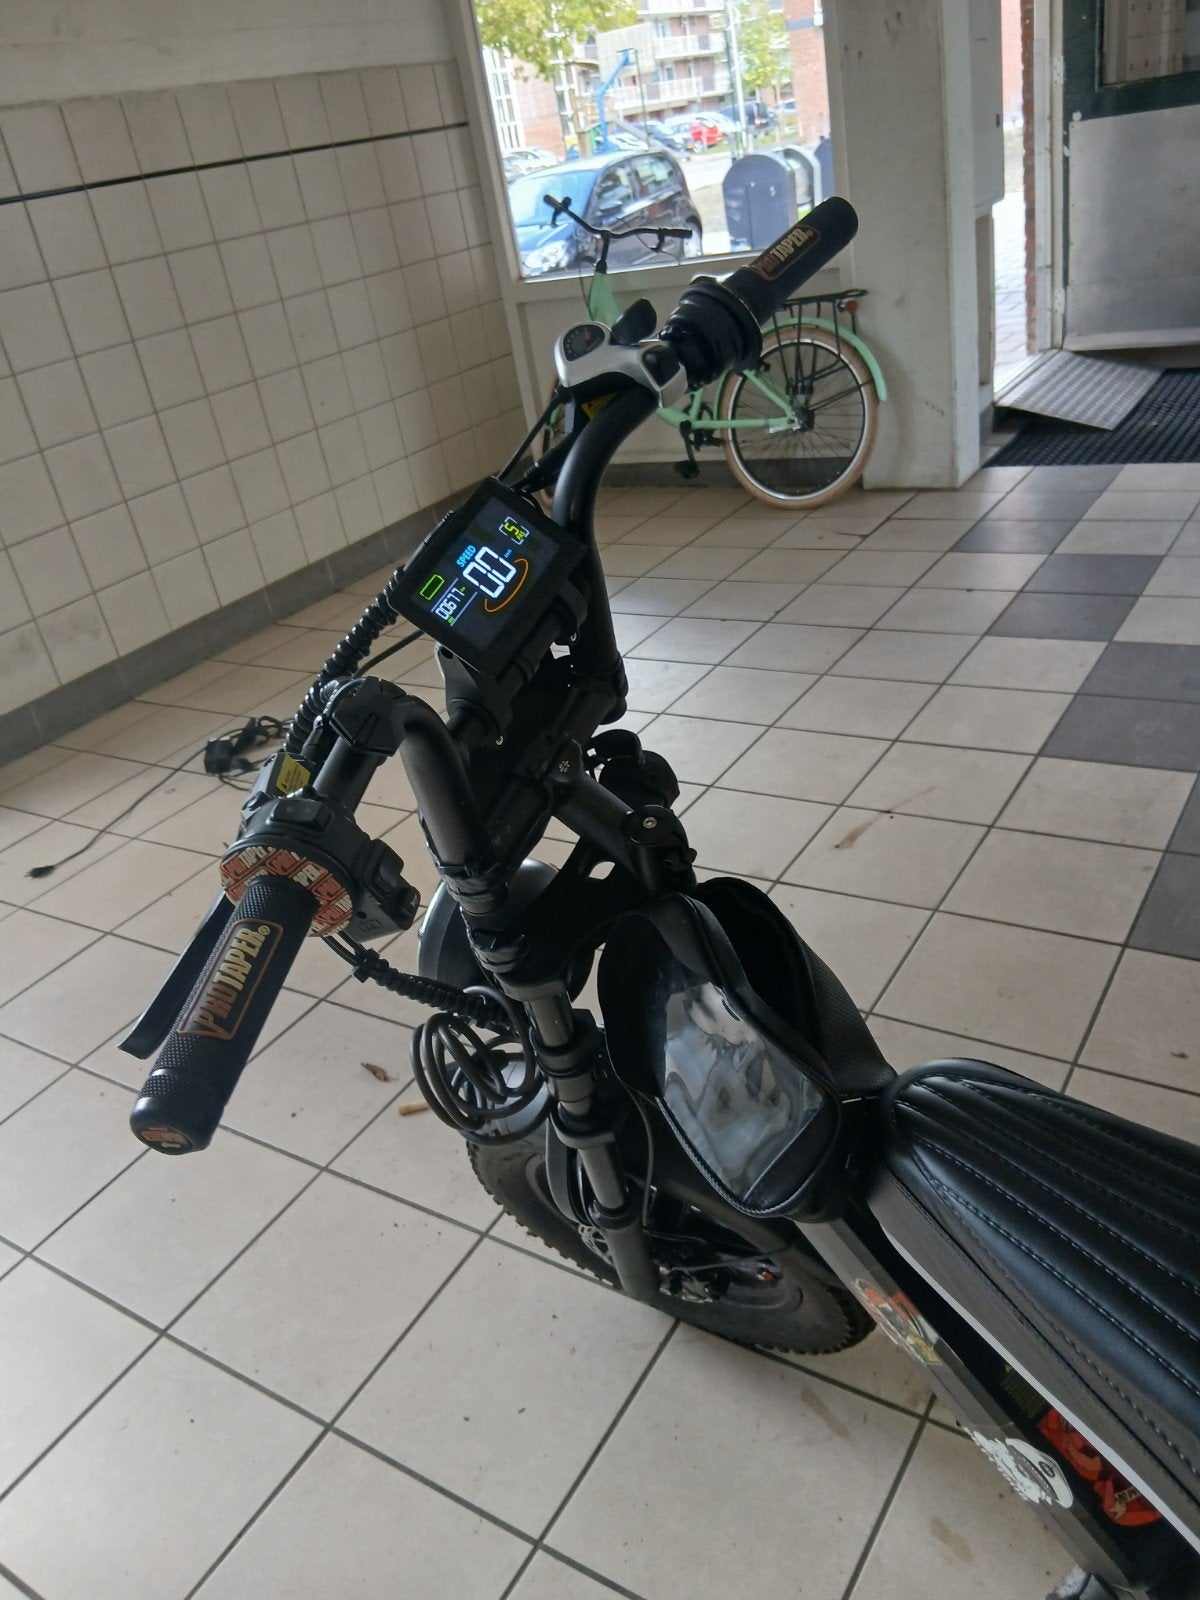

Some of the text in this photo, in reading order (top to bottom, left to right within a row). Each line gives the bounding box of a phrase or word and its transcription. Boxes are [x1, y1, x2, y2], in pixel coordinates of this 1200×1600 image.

[503, 522, 519, 535] 5
[455, 543, 477, 568] SPEED
[435, 587, 464, 619] 00677
